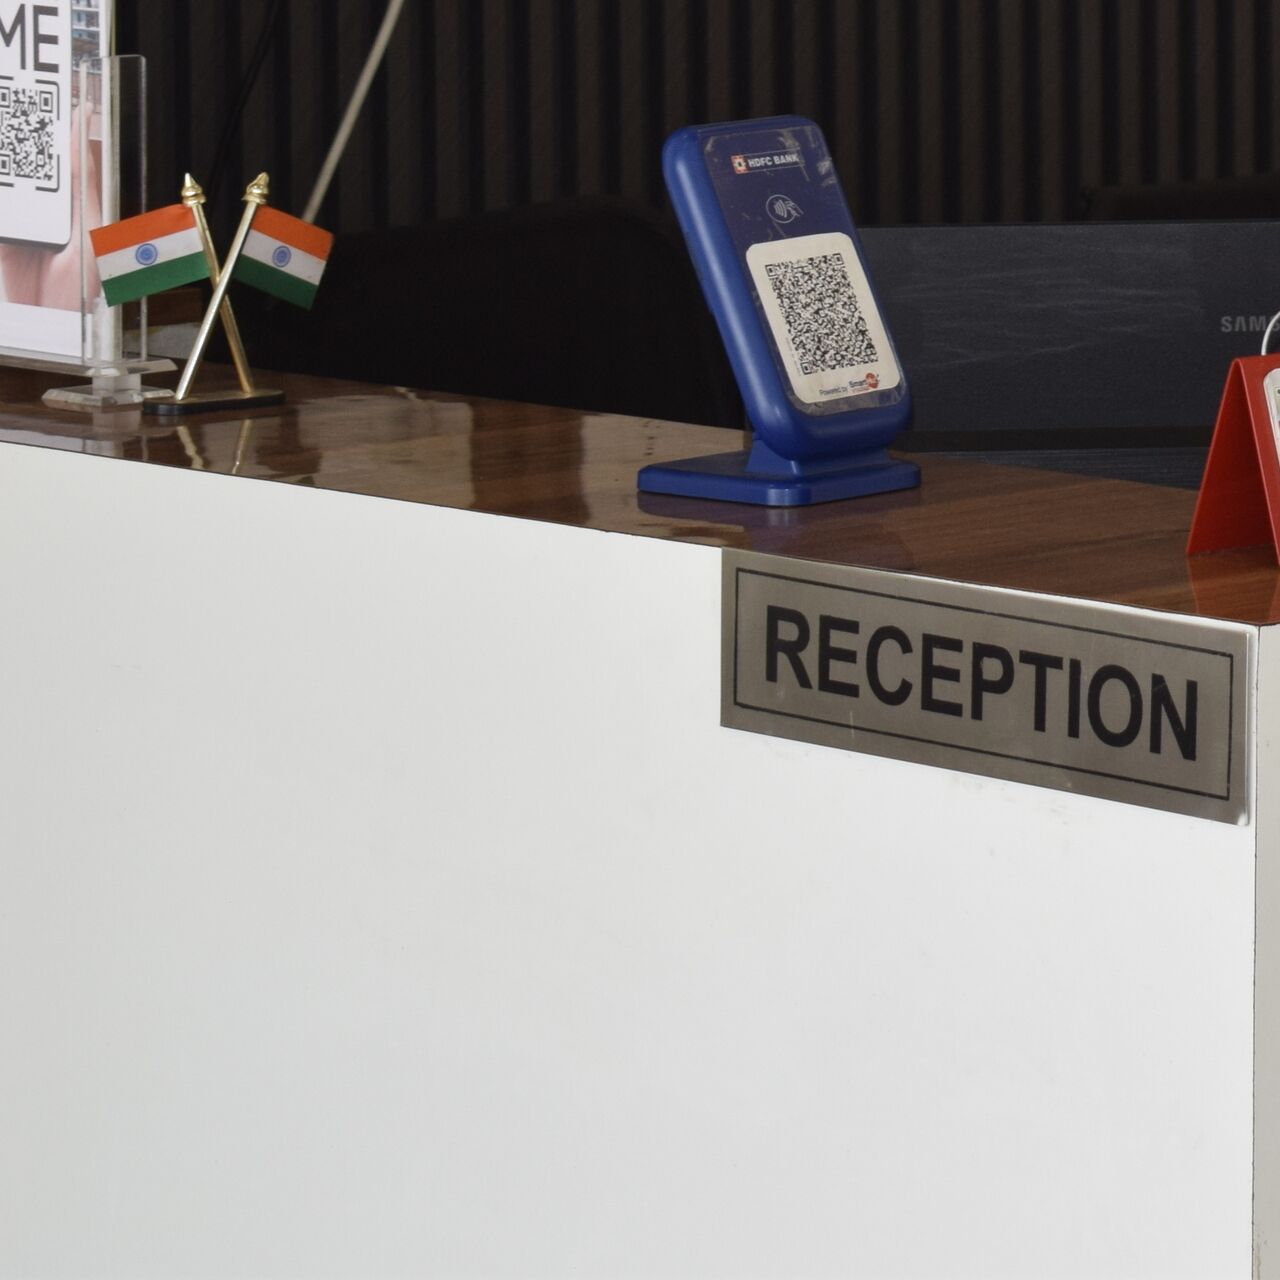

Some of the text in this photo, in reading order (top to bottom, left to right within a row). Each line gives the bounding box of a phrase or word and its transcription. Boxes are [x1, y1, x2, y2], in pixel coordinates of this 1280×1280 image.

[748, 153, 799, 167] HDFC BANK
[765, 604, 1198, 761] RECEPTION
